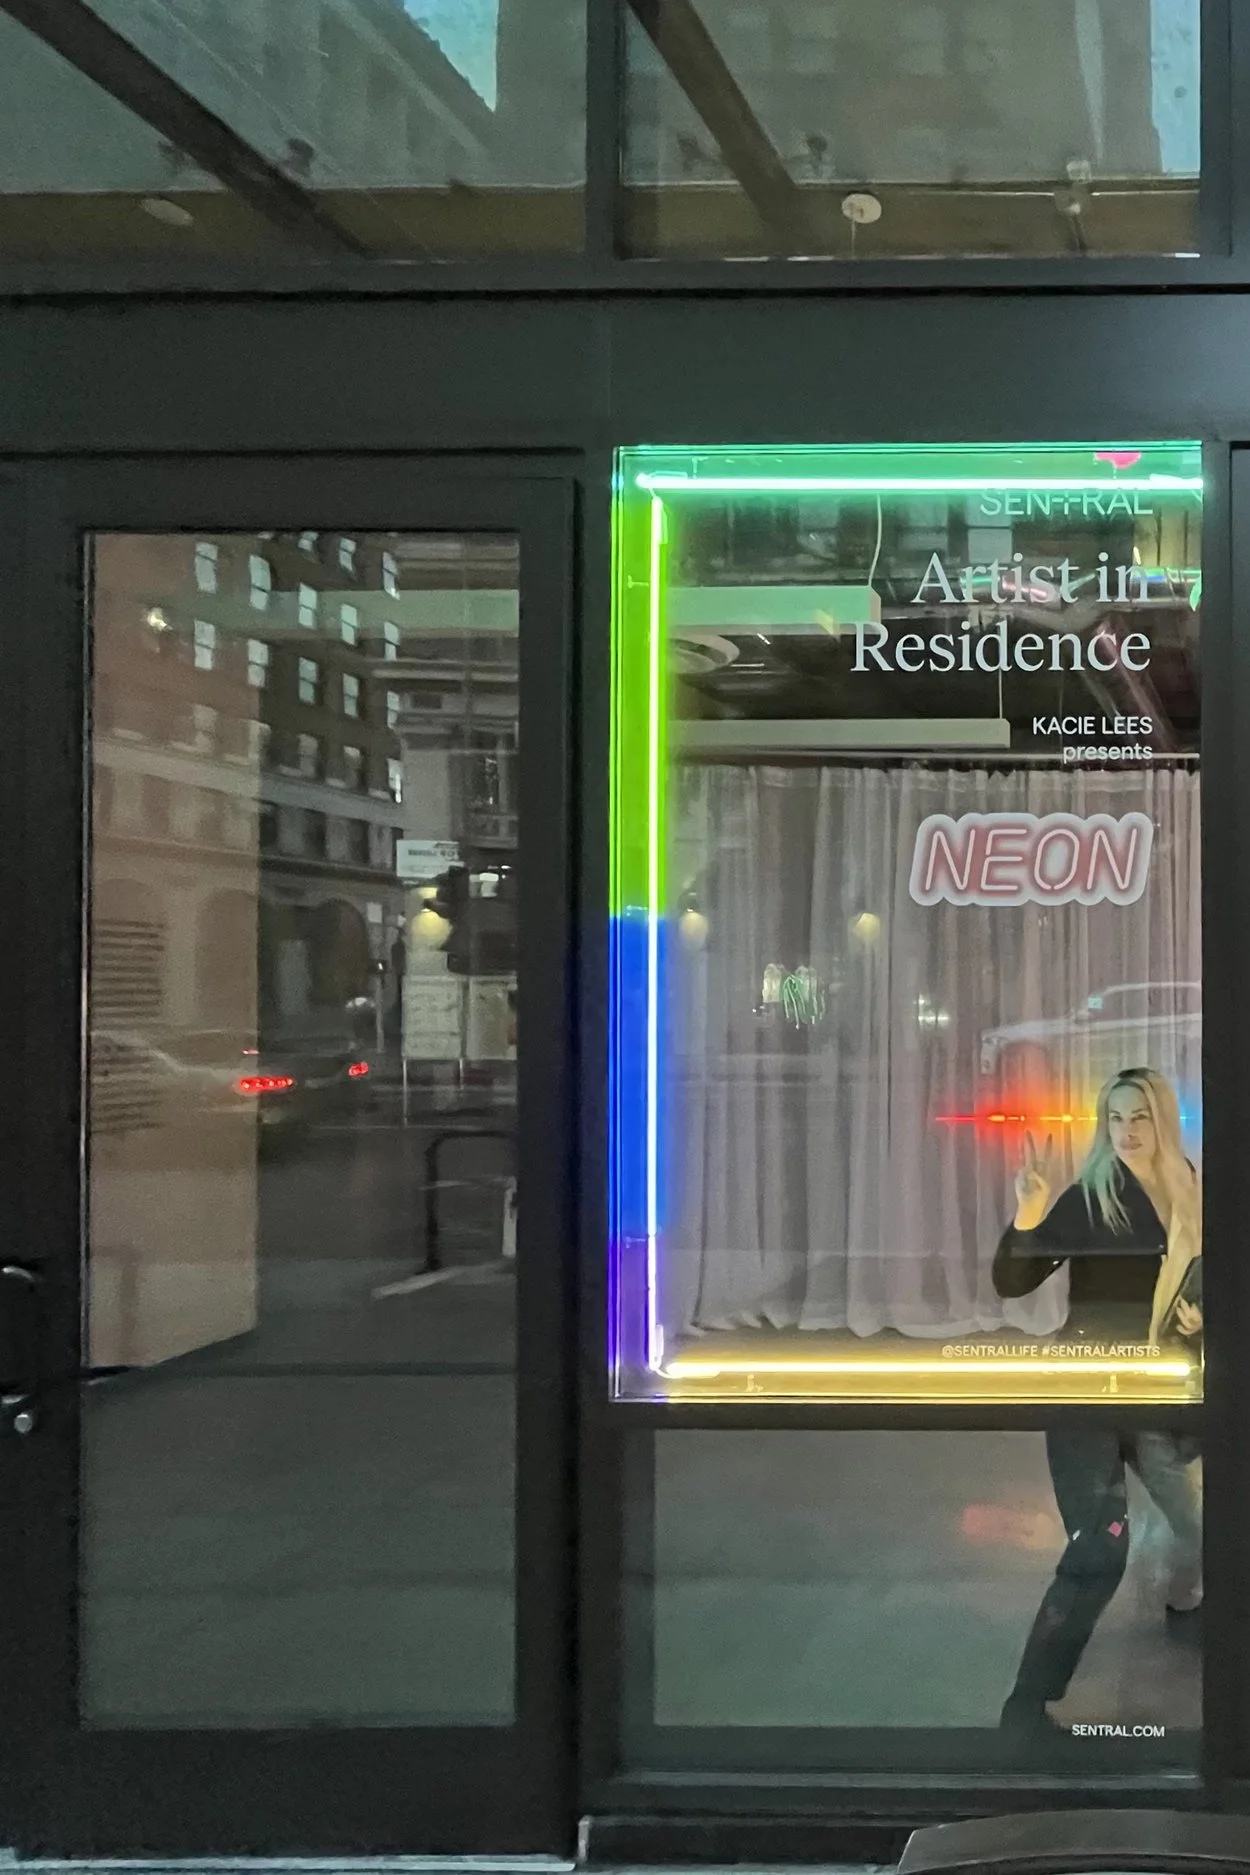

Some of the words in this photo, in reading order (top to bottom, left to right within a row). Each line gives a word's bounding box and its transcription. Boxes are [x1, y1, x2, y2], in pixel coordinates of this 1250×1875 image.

[911, 552, 1080, 604] Artist
[1095, 552, 1151, 604] in
[850, 620, 1152, 672] Residence
[1032, 716, 1096, 736] KACIE
[1101, 716, 1153, 736] LEES
[1062, 743, 1153, 764] presents
[924, 828, 1138, 891] NEON
[942, 1345, 1038, 1358] @SENTRALLIFE
[1041, 1345, 1161, 1358] #SENTRALARTISTS
[1071, 1724, 1165, 1737] SENTRAL.COM
